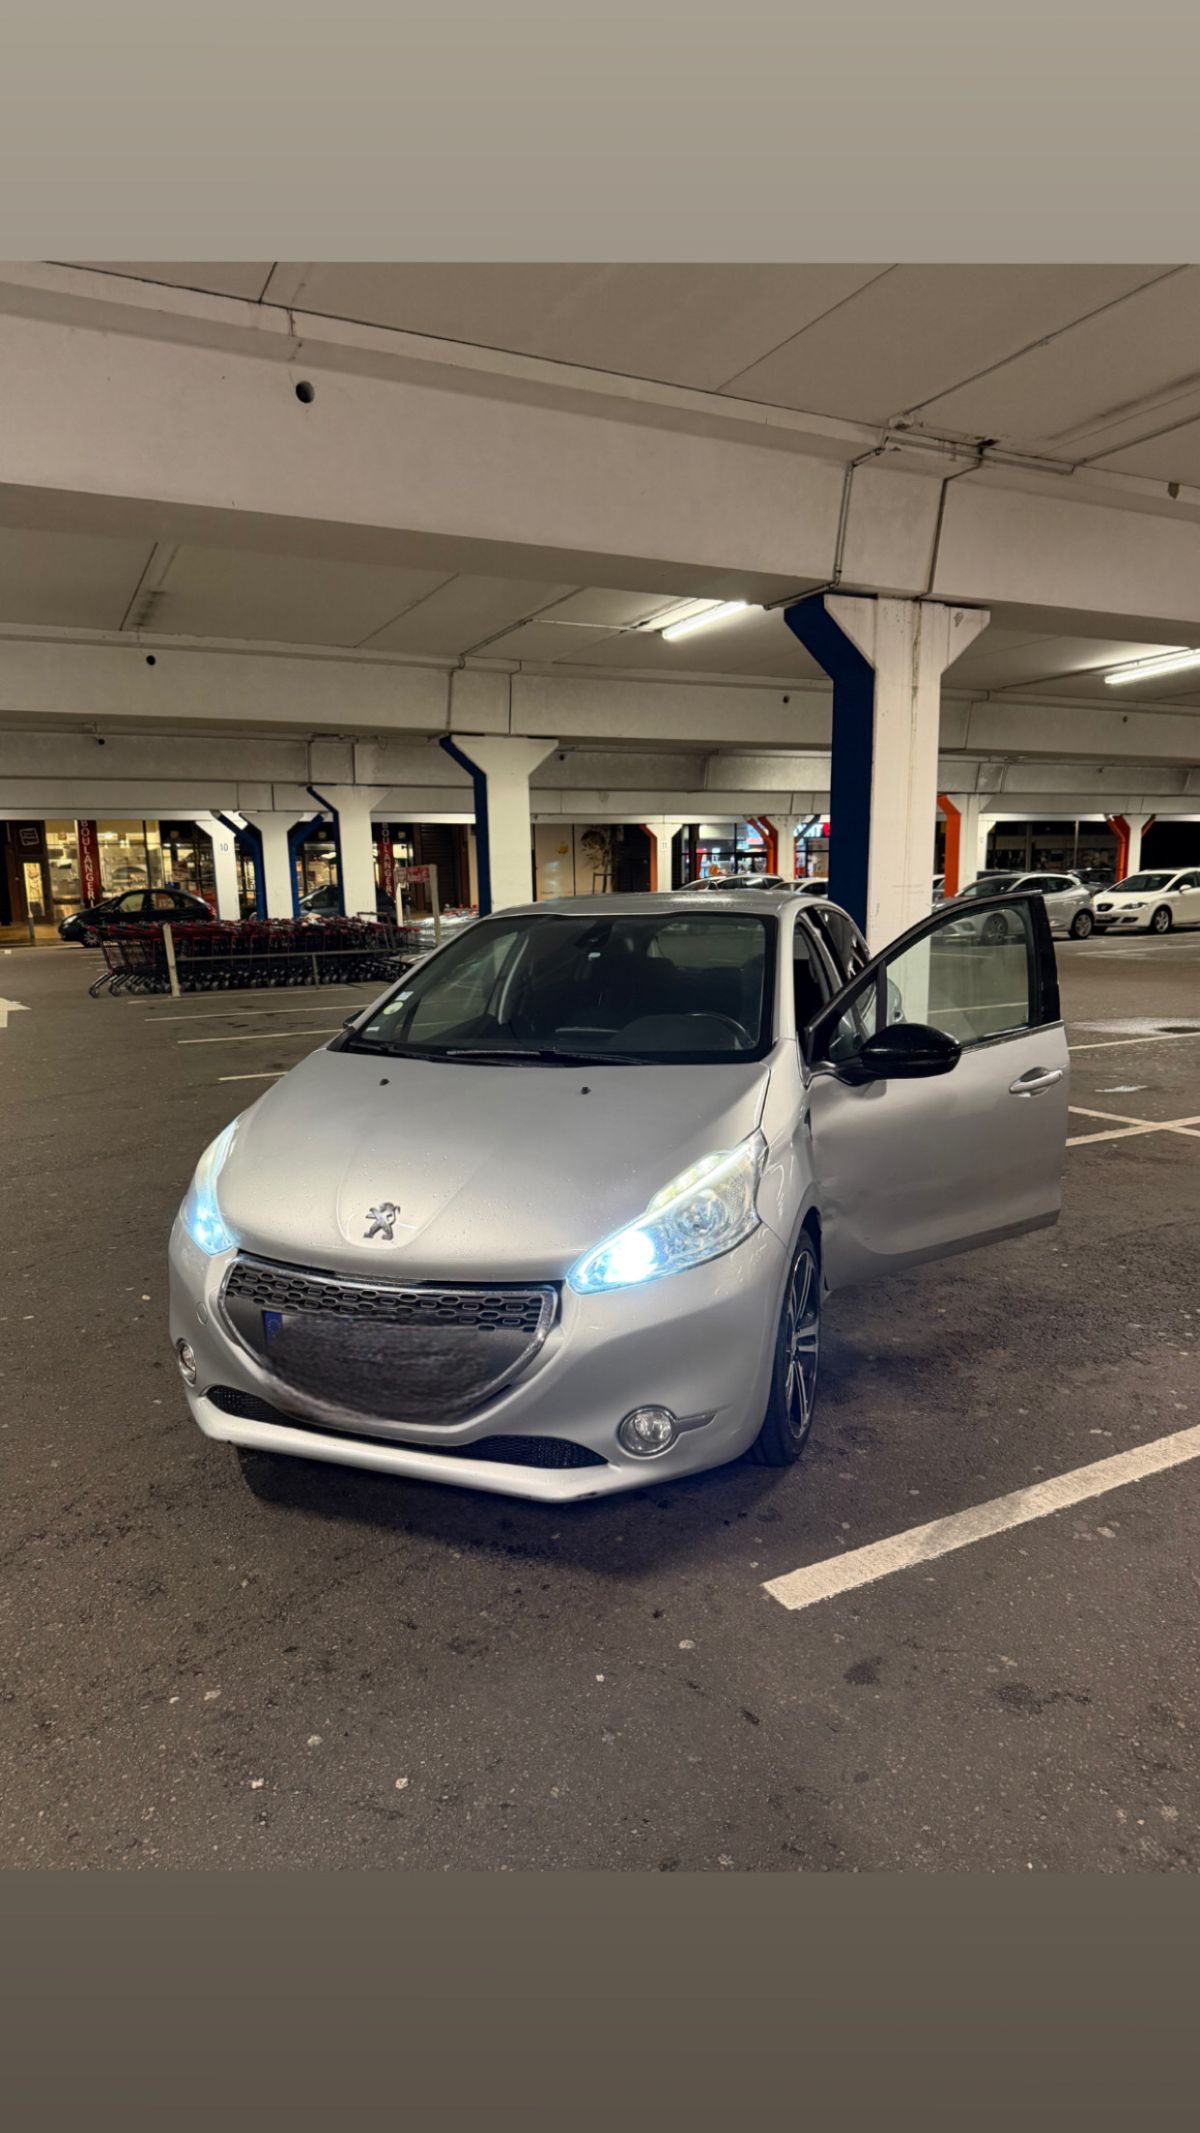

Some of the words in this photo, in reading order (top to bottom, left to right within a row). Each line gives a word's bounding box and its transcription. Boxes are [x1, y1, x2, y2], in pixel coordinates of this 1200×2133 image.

[81, 820, 95, 908] BOULANGERI
[219, 843, 229, 852] 10
[382, 822, 393, 896] BOULANGER
